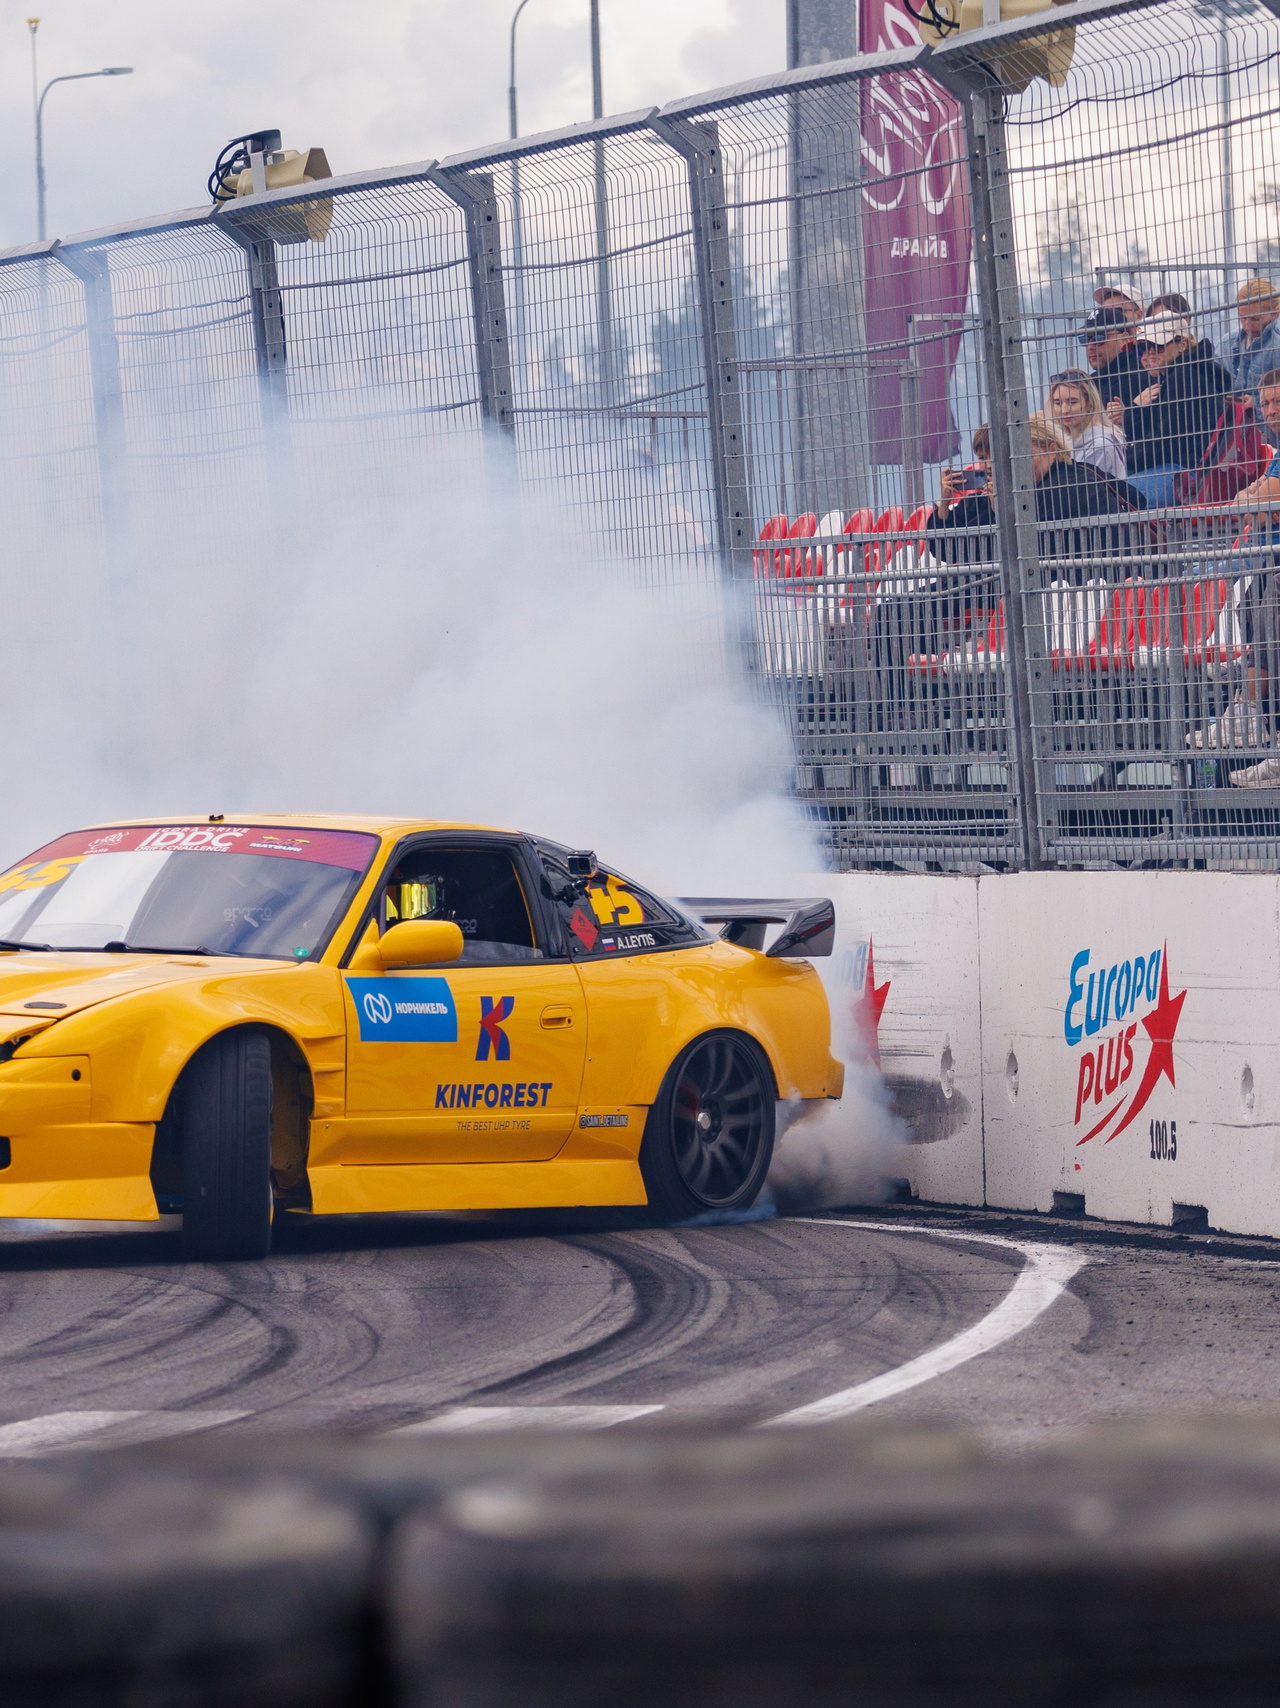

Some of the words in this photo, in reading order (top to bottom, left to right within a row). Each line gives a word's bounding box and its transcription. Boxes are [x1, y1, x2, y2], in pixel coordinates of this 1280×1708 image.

[891, 235, 949, 259] ДРАЙВ
[139, 831, 244, 848] IDDC
[165, 844, 231, 853] CHALLENGE
[617, 933, 656, 950] A.LEYTIS
[395, 1003, 448, 1015] НОРНИКЕЛЬ
[435, 1082, 552, 1108] KINFOREST
[457, 1121, 471, 1131] THE
[473, 1121, 492, 1131] BEST
[494, 1121, 509, 1130] UHP
[511, 1120, 531, 1130] TYRE
[1150, 1119, 1177, 1161] 100.5
